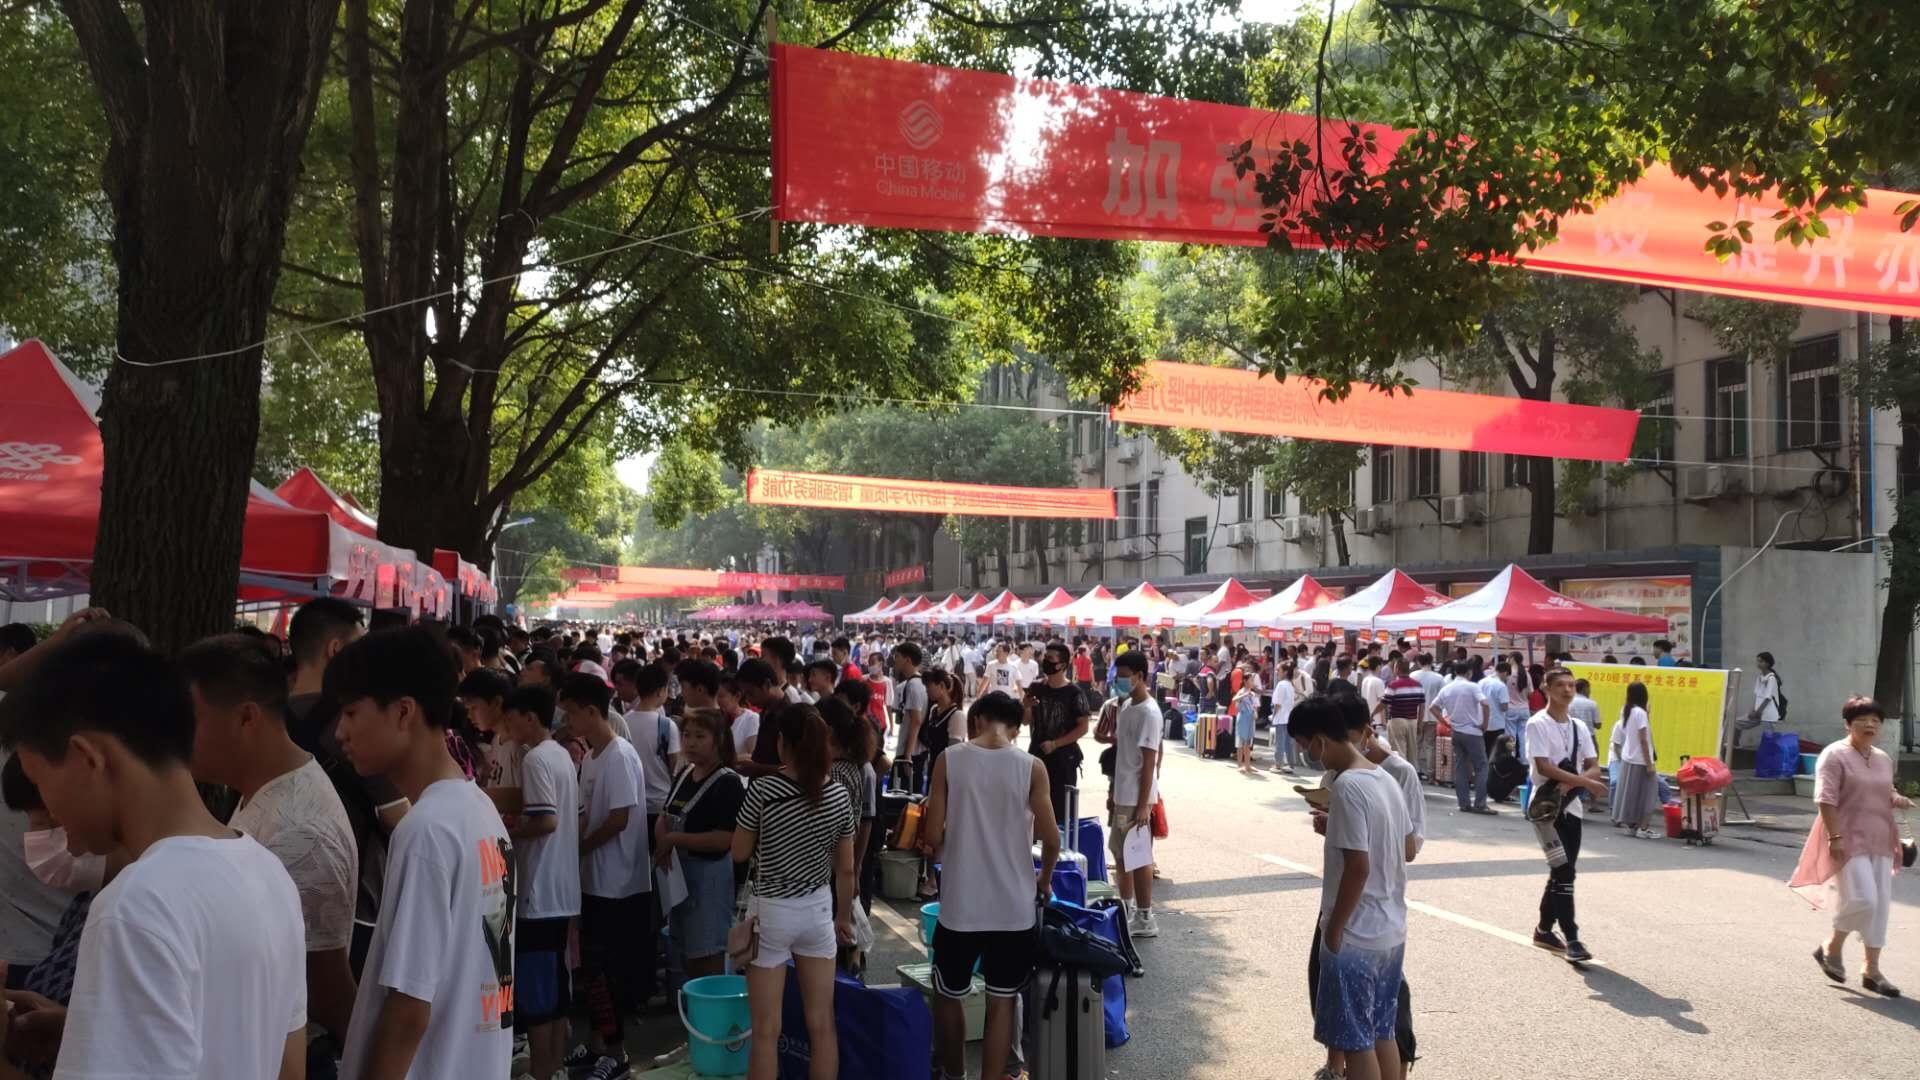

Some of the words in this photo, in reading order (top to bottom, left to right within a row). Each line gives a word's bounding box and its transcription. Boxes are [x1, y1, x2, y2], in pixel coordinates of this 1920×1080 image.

[874, 153, 966, 184] 中国移动
[876, 179, 918, 199] China
